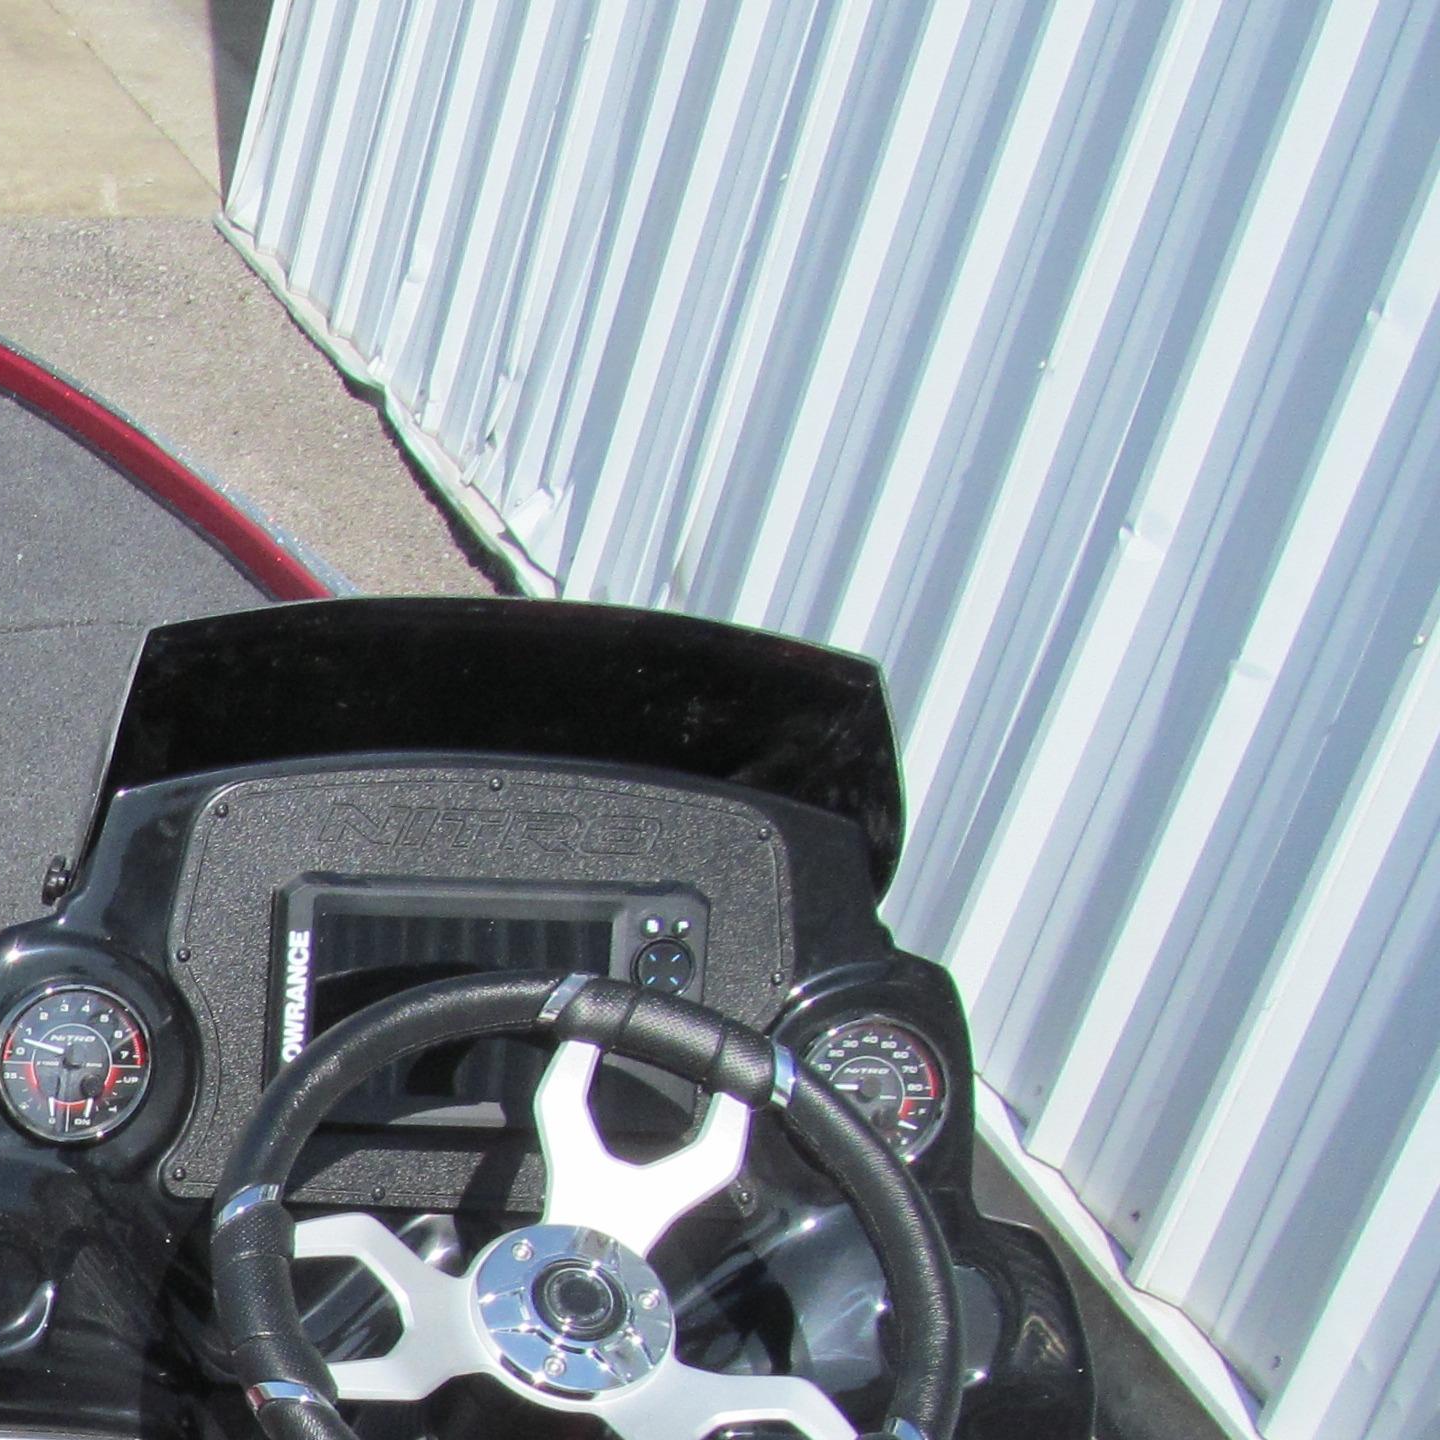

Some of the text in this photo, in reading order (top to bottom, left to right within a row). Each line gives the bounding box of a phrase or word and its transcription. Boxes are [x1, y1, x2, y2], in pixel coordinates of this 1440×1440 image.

[320, 802, 664, 857] NITRO
[282, 929, 313, 1063] OWRANCE
[60, 1004, 69, 1012] 3
[81, 1004, 91, 1013] 4
[39, 1012, 49, 1020] 2
[100, 1014, 109, 1023] 5
[842, 1040, 859, 1048] 30
[862, 1036, 879, 1044] 40
[881, 1041, 897, 1049] 50
[16, 1047, 25, 1055] 0
[120, 1051, 129, 1059] 7
[828, 1049, 845, 1057] 20
[844, 1067, 890, 1075] NITRO
[902, 1065, 918, 1073] 70
